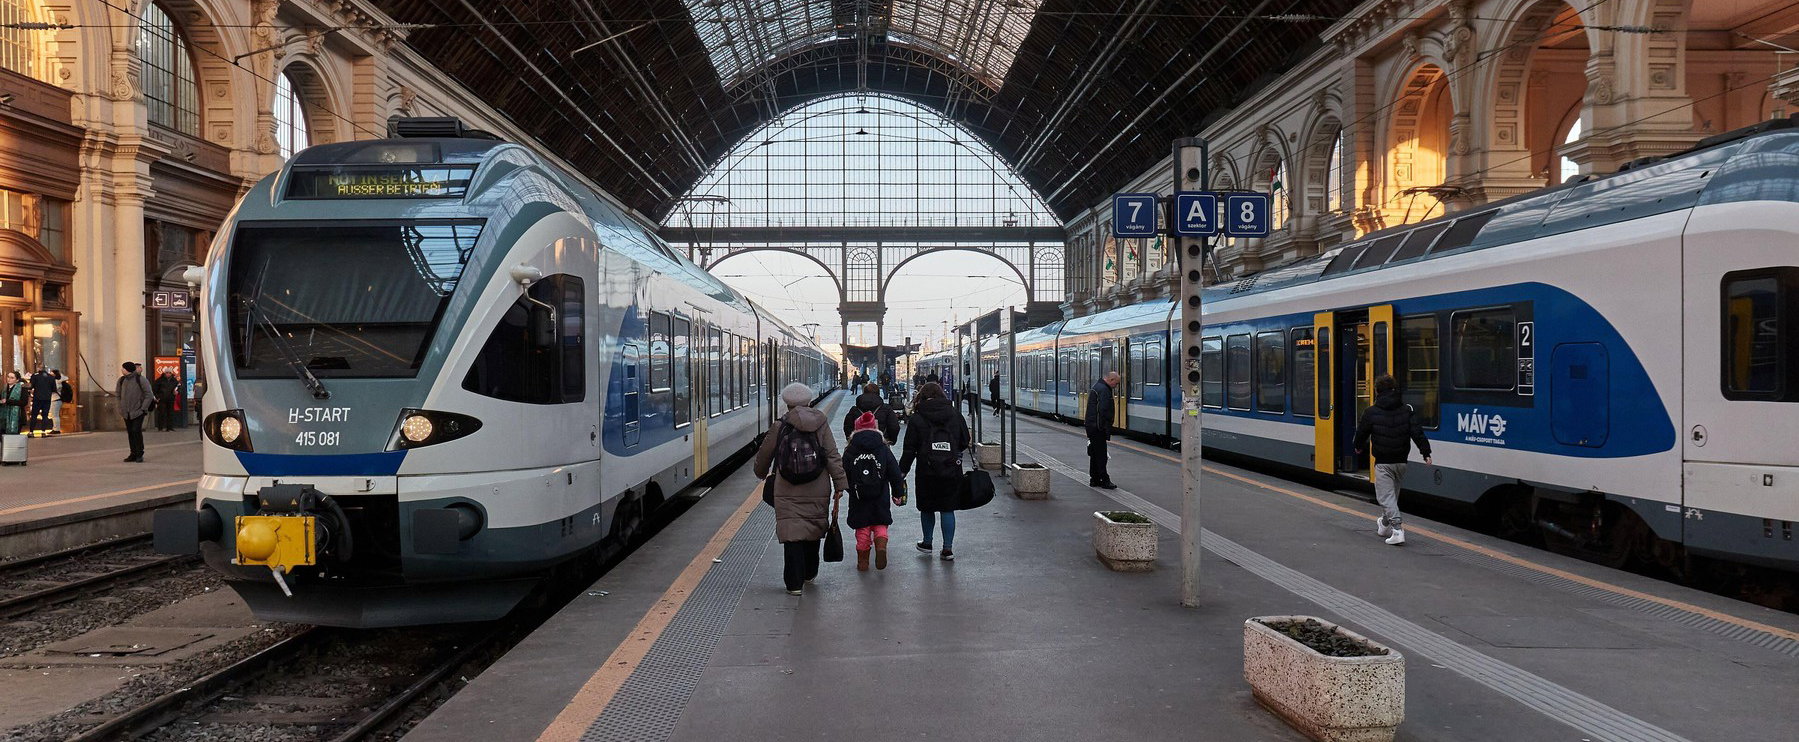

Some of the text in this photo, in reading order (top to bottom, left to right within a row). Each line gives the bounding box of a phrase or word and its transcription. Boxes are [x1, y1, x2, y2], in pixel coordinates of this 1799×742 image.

[338, 184, 385, 195] AUSSER
[361, 175, 377, 184] IN
[1128, 201, 1143, 223] 7
[1186, 200, 1207, 222] A
[1240, 201, 1255, 223] 8
[1521, 325, 1530, 346] 2
[288, 407, 351, 423] H-START
[1457, 408, 1489, 434] MÁV
[295, 431, 340, 446] 415 081
